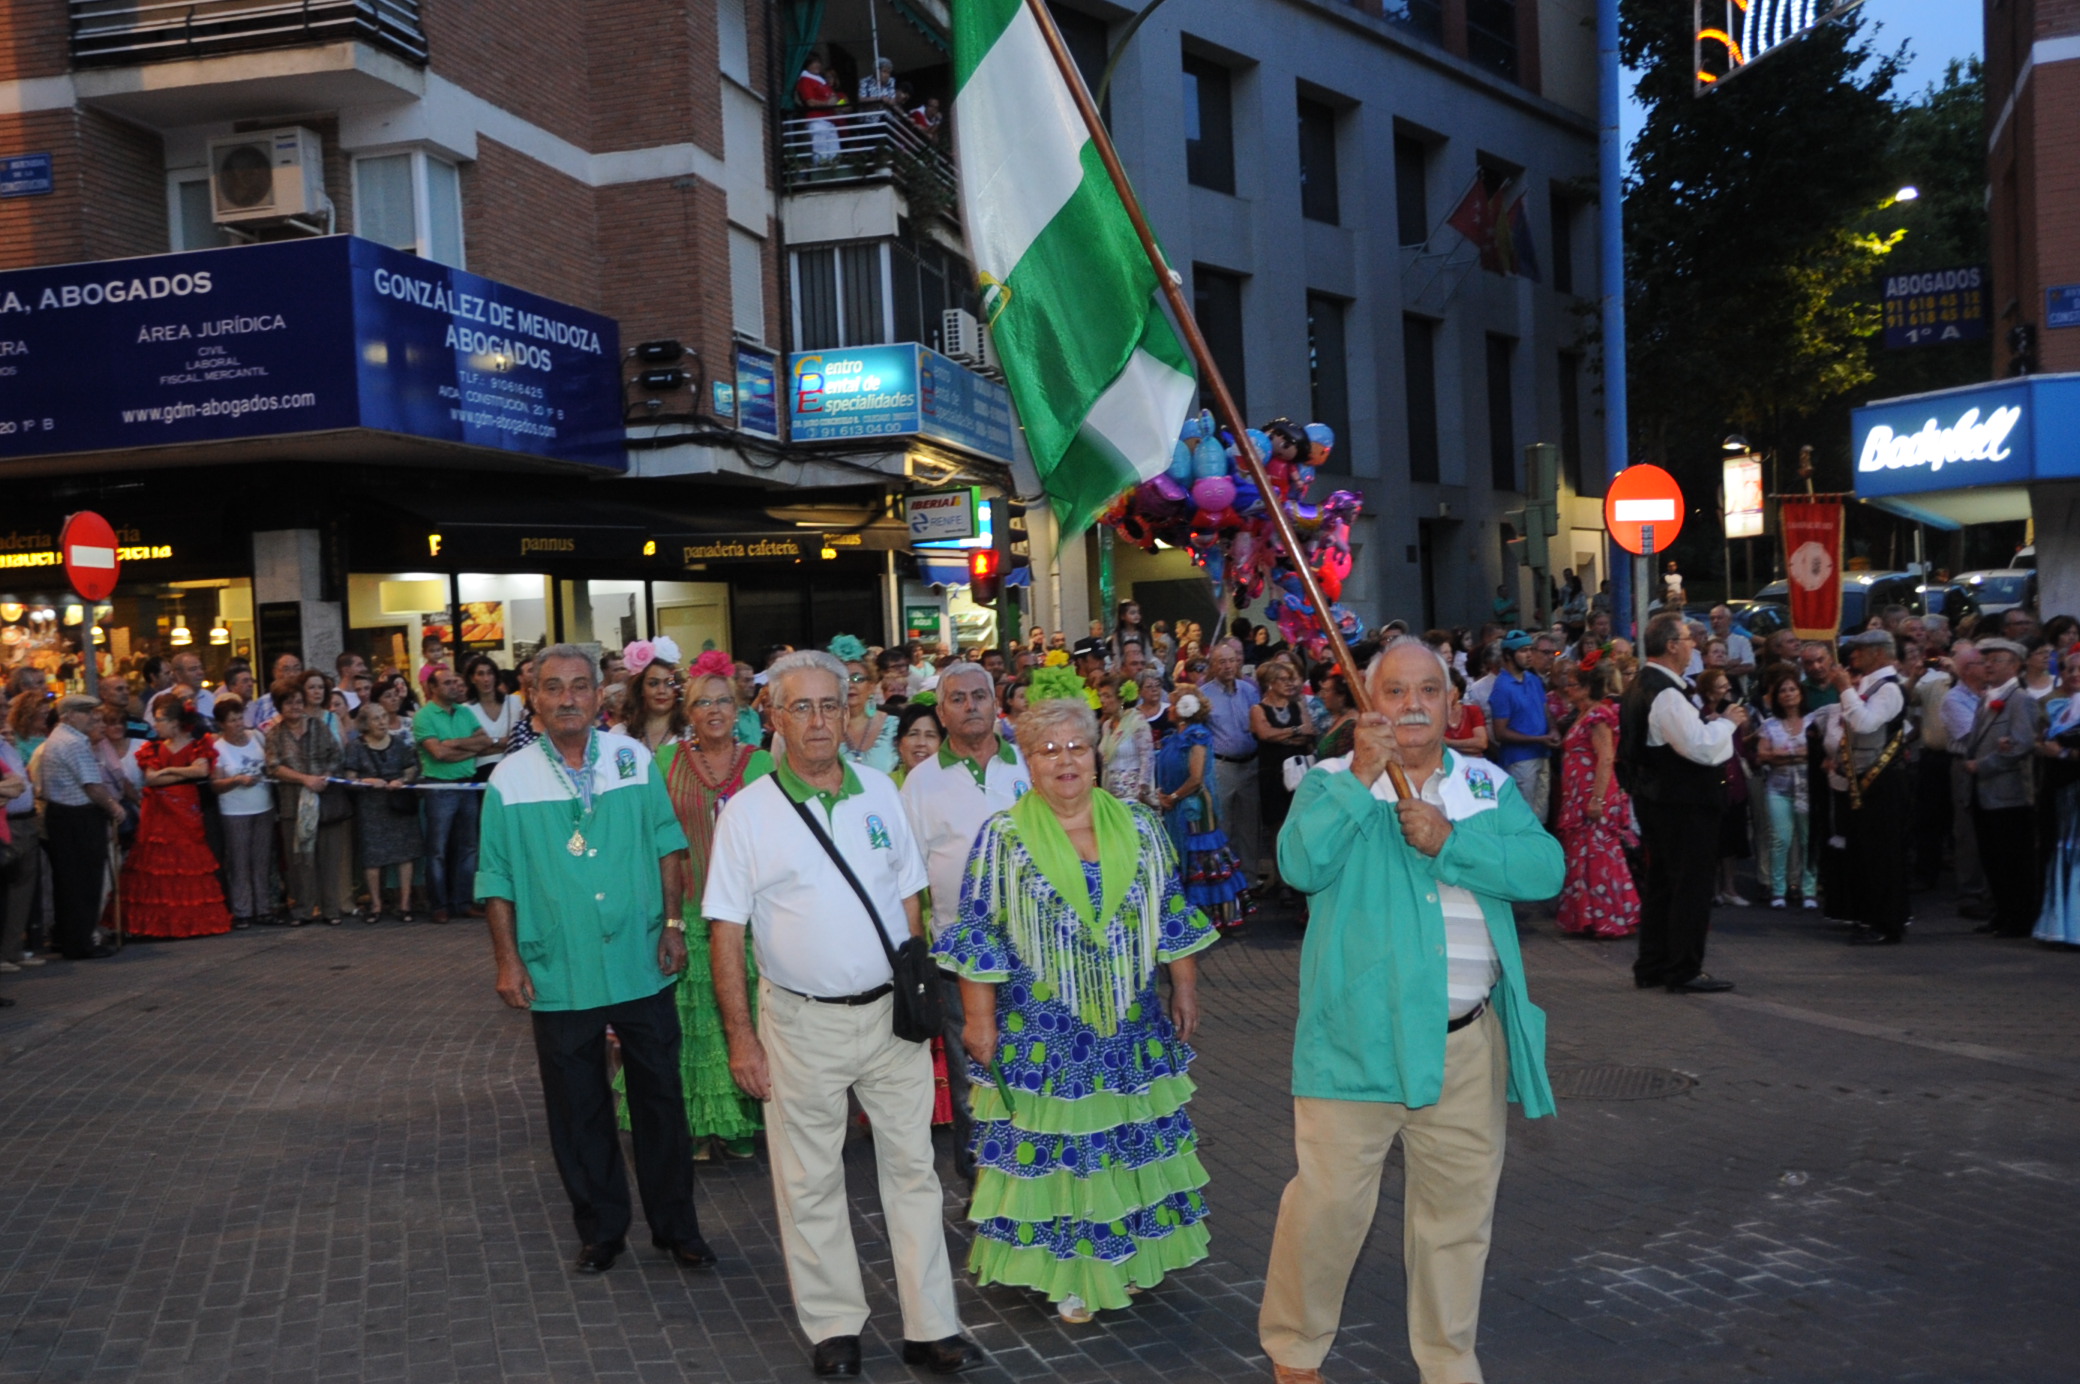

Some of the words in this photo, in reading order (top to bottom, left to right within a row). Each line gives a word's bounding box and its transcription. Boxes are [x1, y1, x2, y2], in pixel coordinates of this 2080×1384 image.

[1886, 267, 1981, 298] ABOGADOS
[0, 291, 32, 315] A,
[38, 271, 212, 310] ABOGADOS
[374, 268, 486, 323] GONZÁLEZ
[489, 301, 515, 331] DE
[518, 310, 602, 355] MENDOZA
[137, 324, 192, 344] ÁREA
[196, 314, 287, 338] JURÍDICA
[1940, 325, 1962, 341] A
[198, 345, 228, 357] CIVIL
[445, 324, 553, 372] ABOGADOS
[185, 357, 241, 371] LABORAL
[204, 366, 269, 382] MERCANTIL
[863, 374, 881, 392] de
[122, 393, 317, 425] www.gdm-abogados.com
[42, 418, 55, 432] B
[450, 406, 557, 439] www.gdm-abogados.com
[821, 427, 837, 438] 91
[840, 424, 864, 436] 613
[1858, 405, 2021, 473] Bodybell
[910, 497, 951, 511] IBERIA
[930, 514, 964, 527] RENFE
[521, 537, 575, 556] pannus
[683, 540, 745, 564] panadería
[747, 539, 799, 557] cafetería
